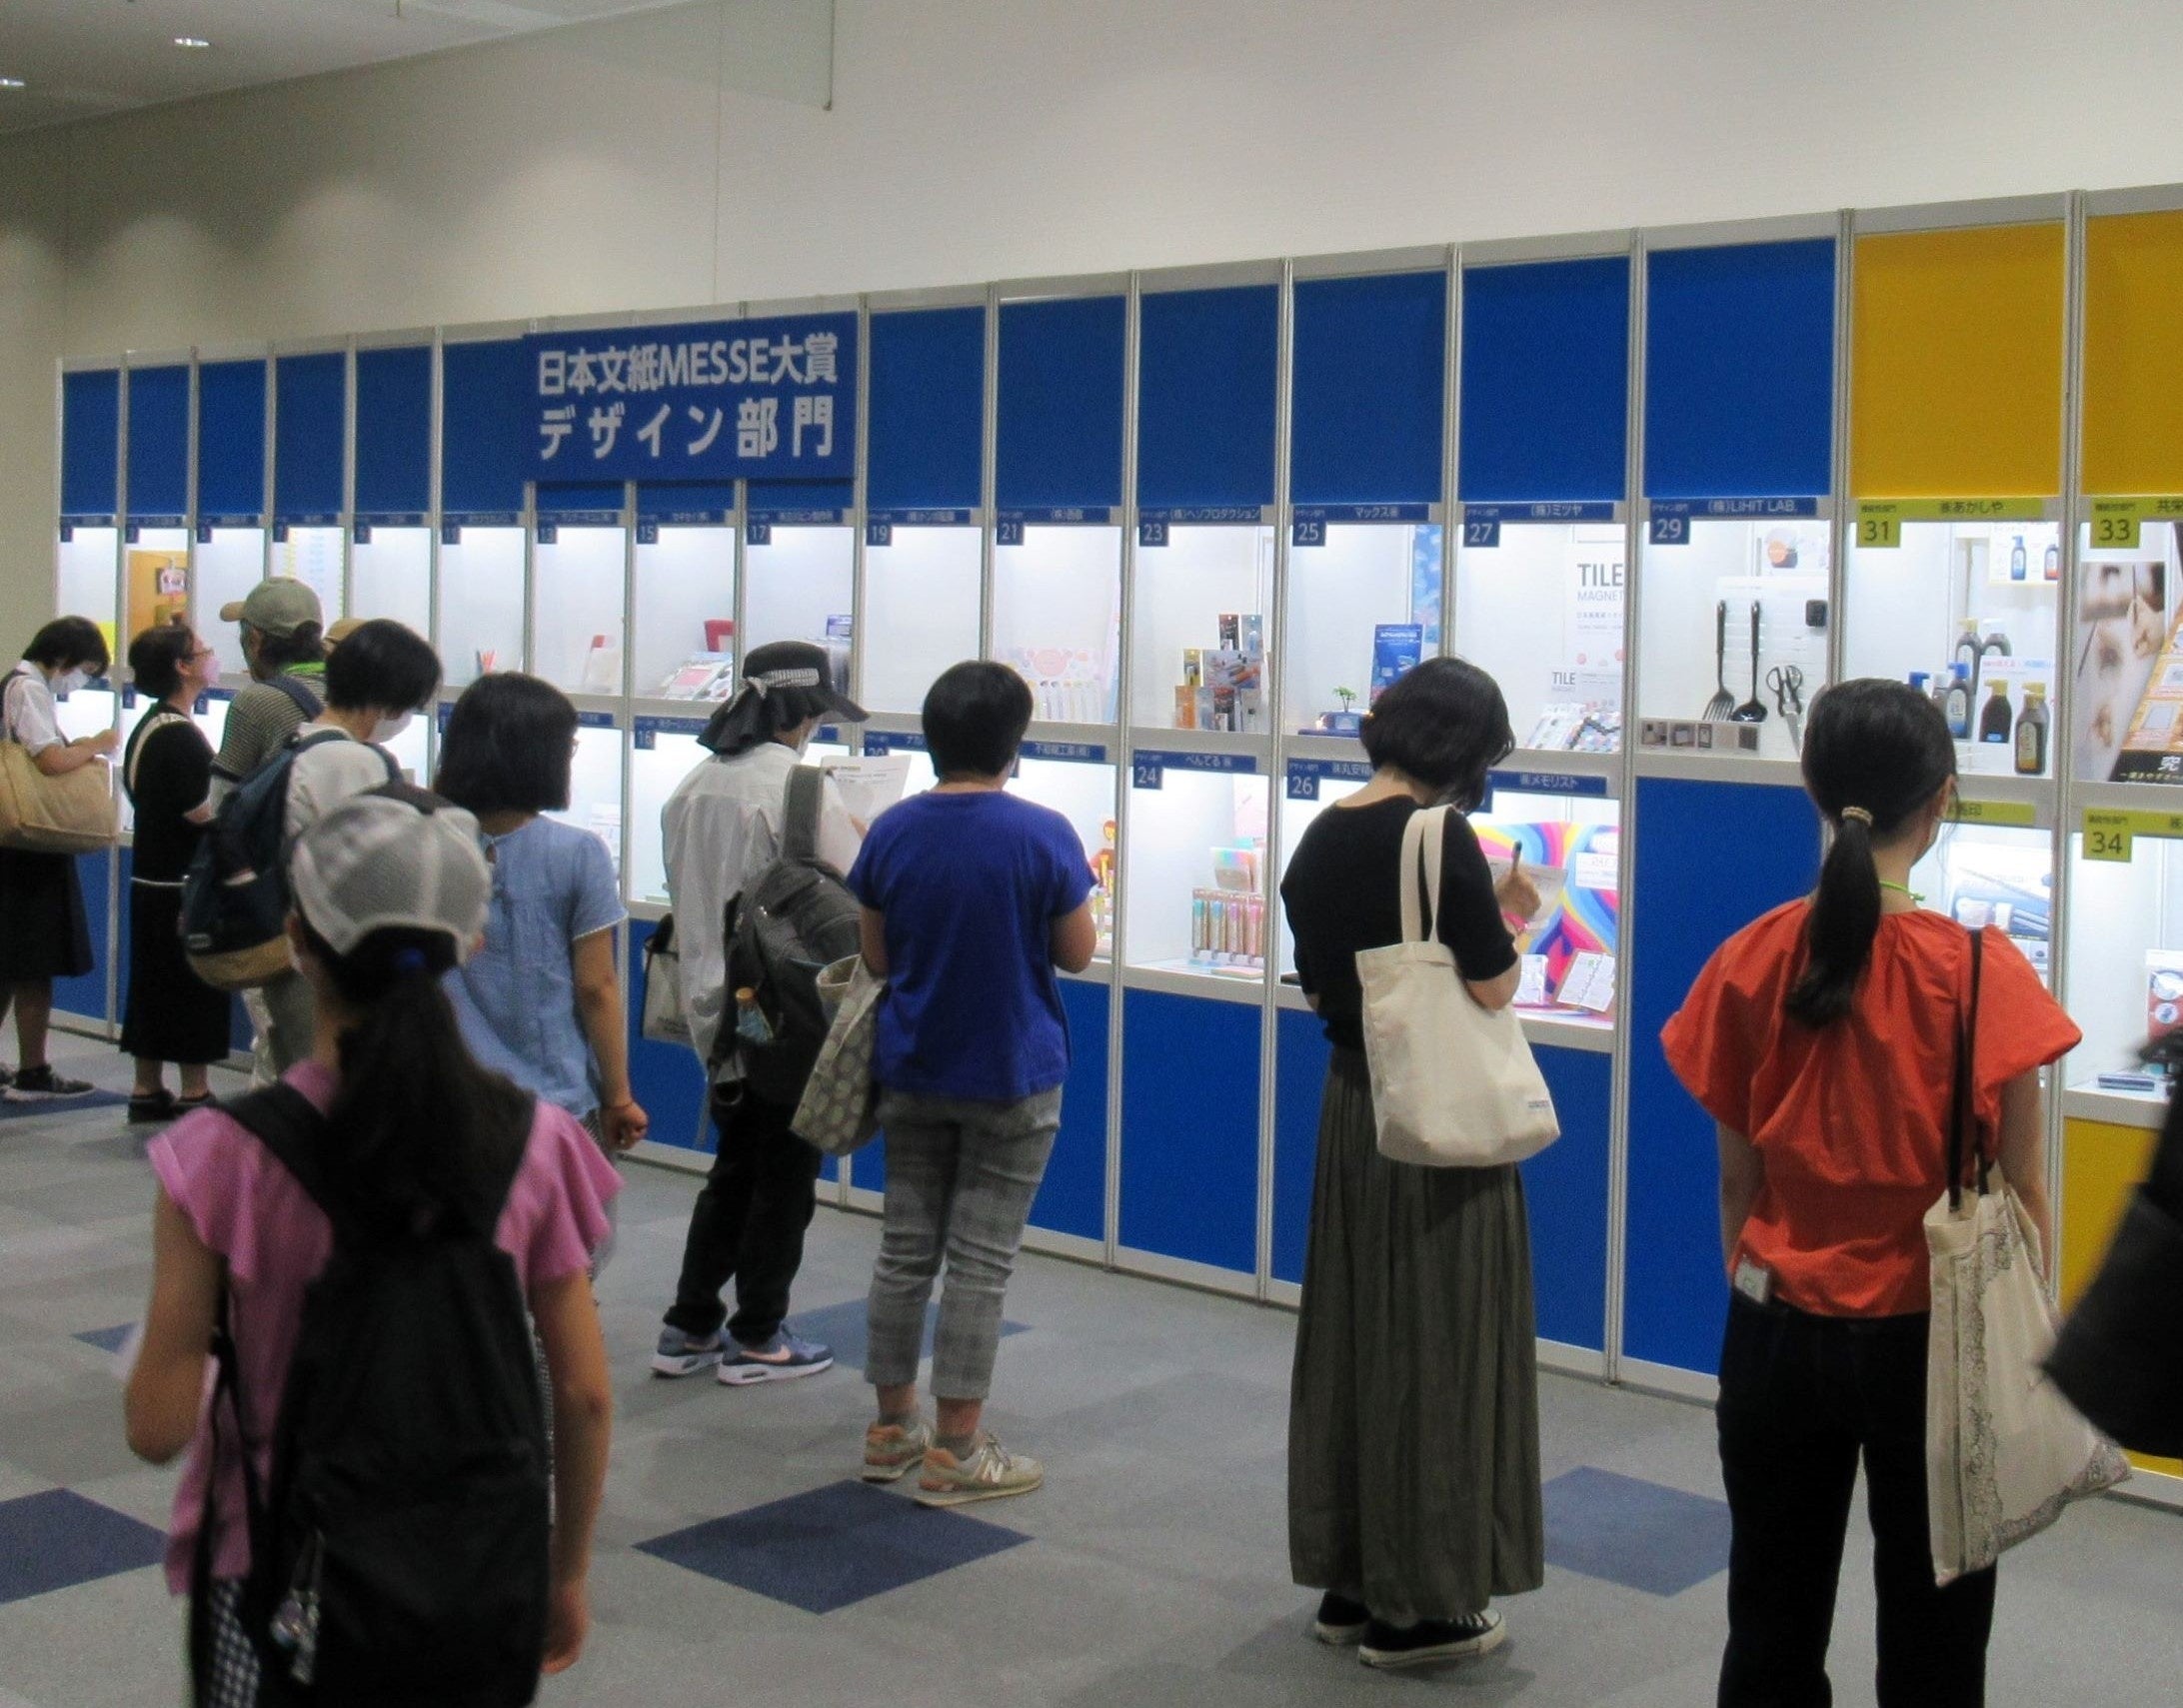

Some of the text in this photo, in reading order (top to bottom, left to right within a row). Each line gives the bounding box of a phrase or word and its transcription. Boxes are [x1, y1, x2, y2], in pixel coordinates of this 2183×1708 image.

[539, 332, 838, 396] 日本文紙MESSE大賞
[540, 395, 835, 460] デザイン部門
[752, 525, 767, 540] 17
[872, 525, 888, 542] 19
[1002, 523, 1018, 540] 21
[1143, 523, 1162, 542] 23
[1298, 523, 1318, 542] 25
[1469, 523, 1493, 543] 27
[1655, 518, 1682, 539] 29
[1864, 520, 1889, 541] 31
[2099, 519, 2131, 541] 33
[1577, 563, 1623, 587] TILE
[1551, 671, 1576, 686] TILE
[1137, 766, 1157, 785] 24
[1291, 776, 1313, 796] 26
[2091, 831, 2123, 854] 34
